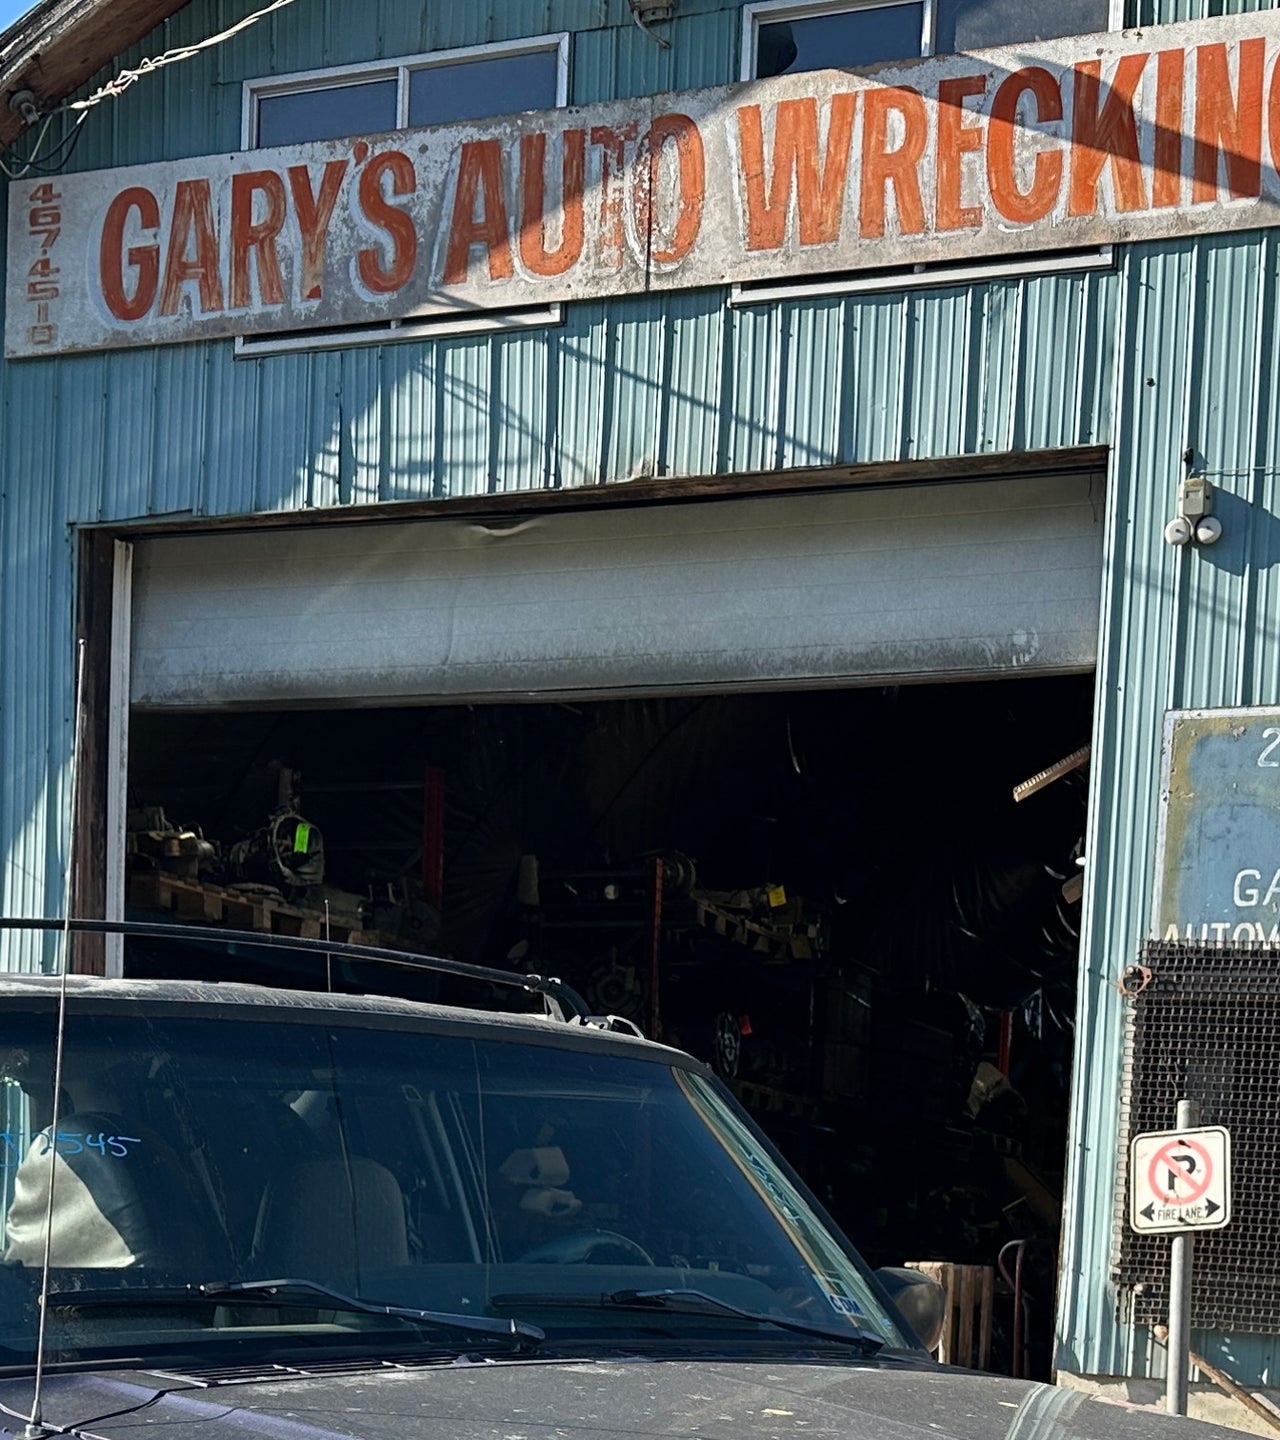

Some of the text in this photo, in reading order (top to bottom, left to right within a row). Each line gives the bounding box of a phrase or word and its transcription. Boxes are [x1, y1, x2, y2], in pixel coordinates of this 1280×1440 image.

[99, 142, 417, 321] GARY'S
[443, 113, 704, 285] AUTO
[1158, 1208, 1177, 1221] FIRE
